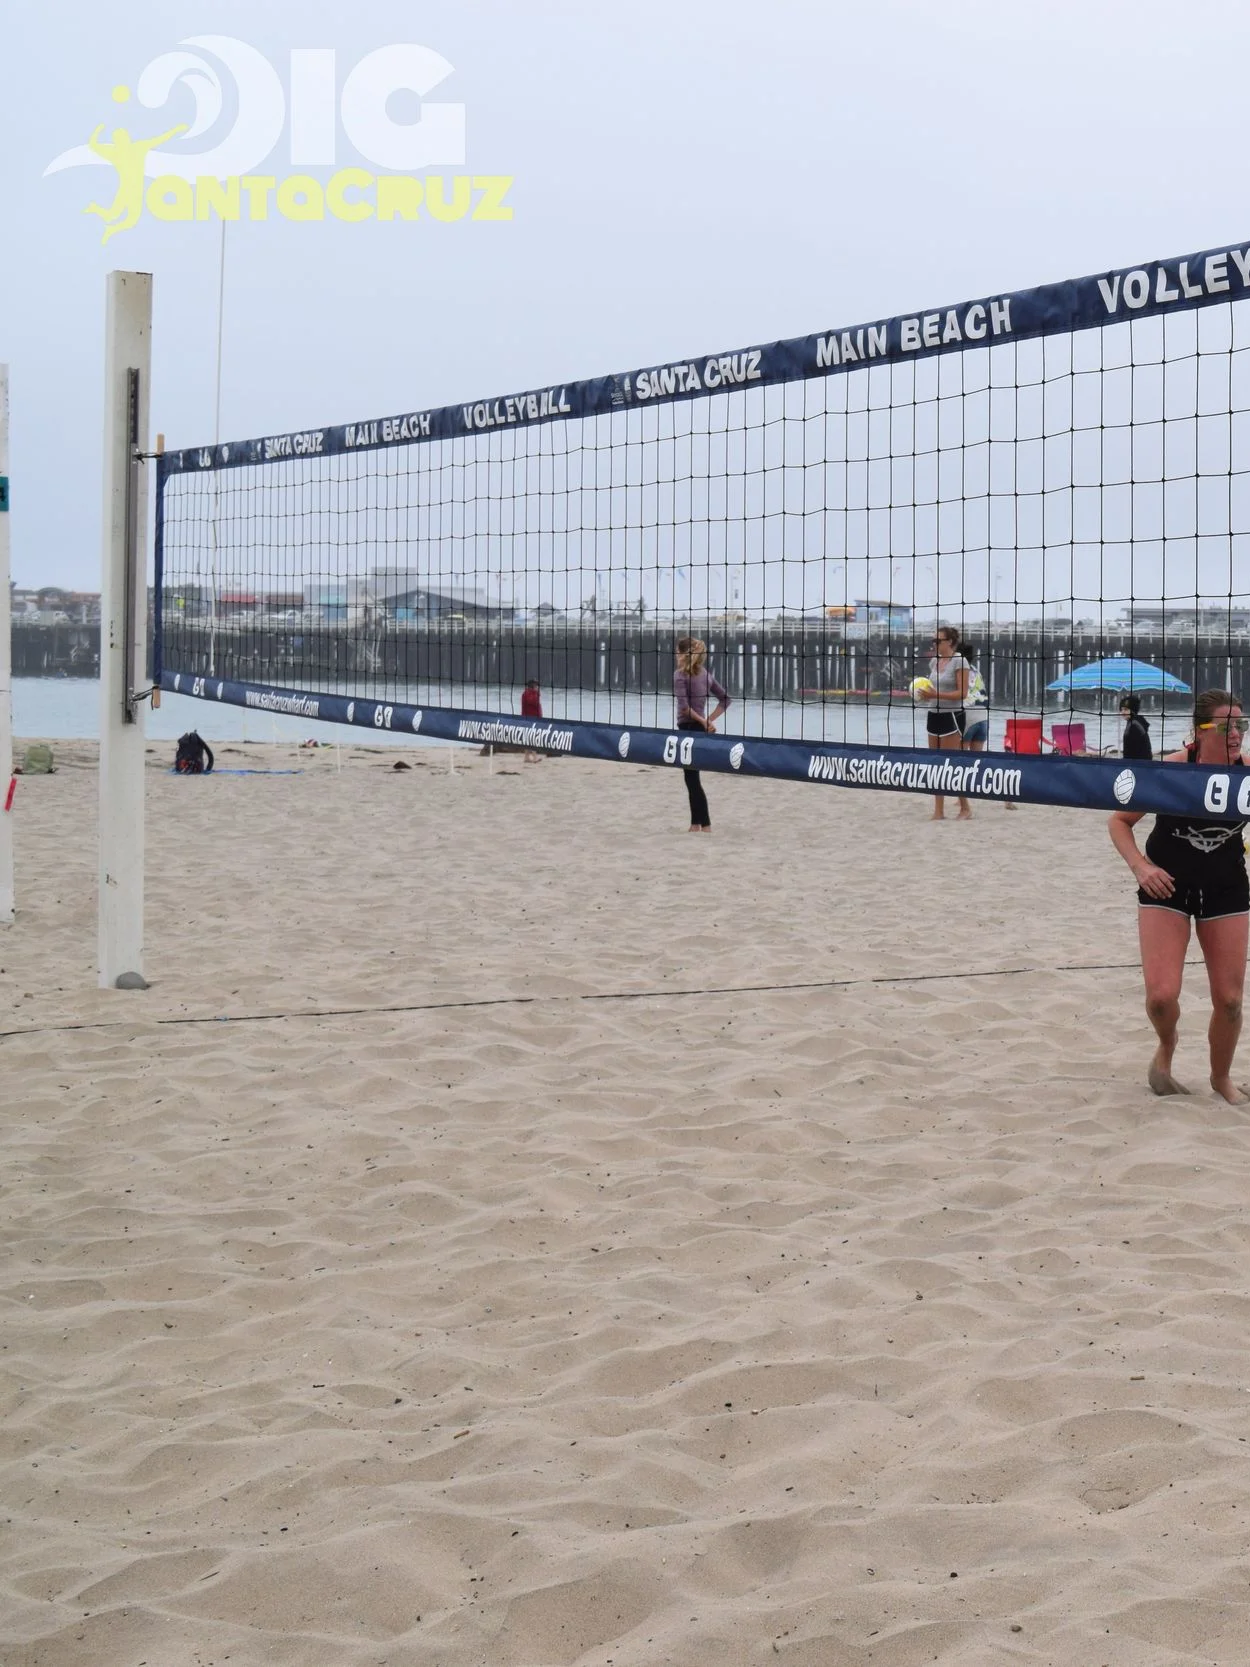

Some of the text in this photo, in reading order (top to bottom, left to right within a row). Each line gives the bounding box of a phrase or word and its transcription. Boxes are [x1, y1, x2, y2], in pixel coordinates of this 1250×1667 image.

[636, 363, 701, 400] SANTA
[703, 350, 762, 389] CRUZ
[816, 324, 888, 368] MAIN
[900, 299, 1012, 352] BEACH
[345, 422, 378, 447] MAIN
[383, 414, 431, 441] BEACH
[463, 388, 571, 429] VOLLEYBALL
[458, 719, 573, 751] www.santacruzwharf.com
[807, 754, 1021, 796] www.santacruzwharf.com
